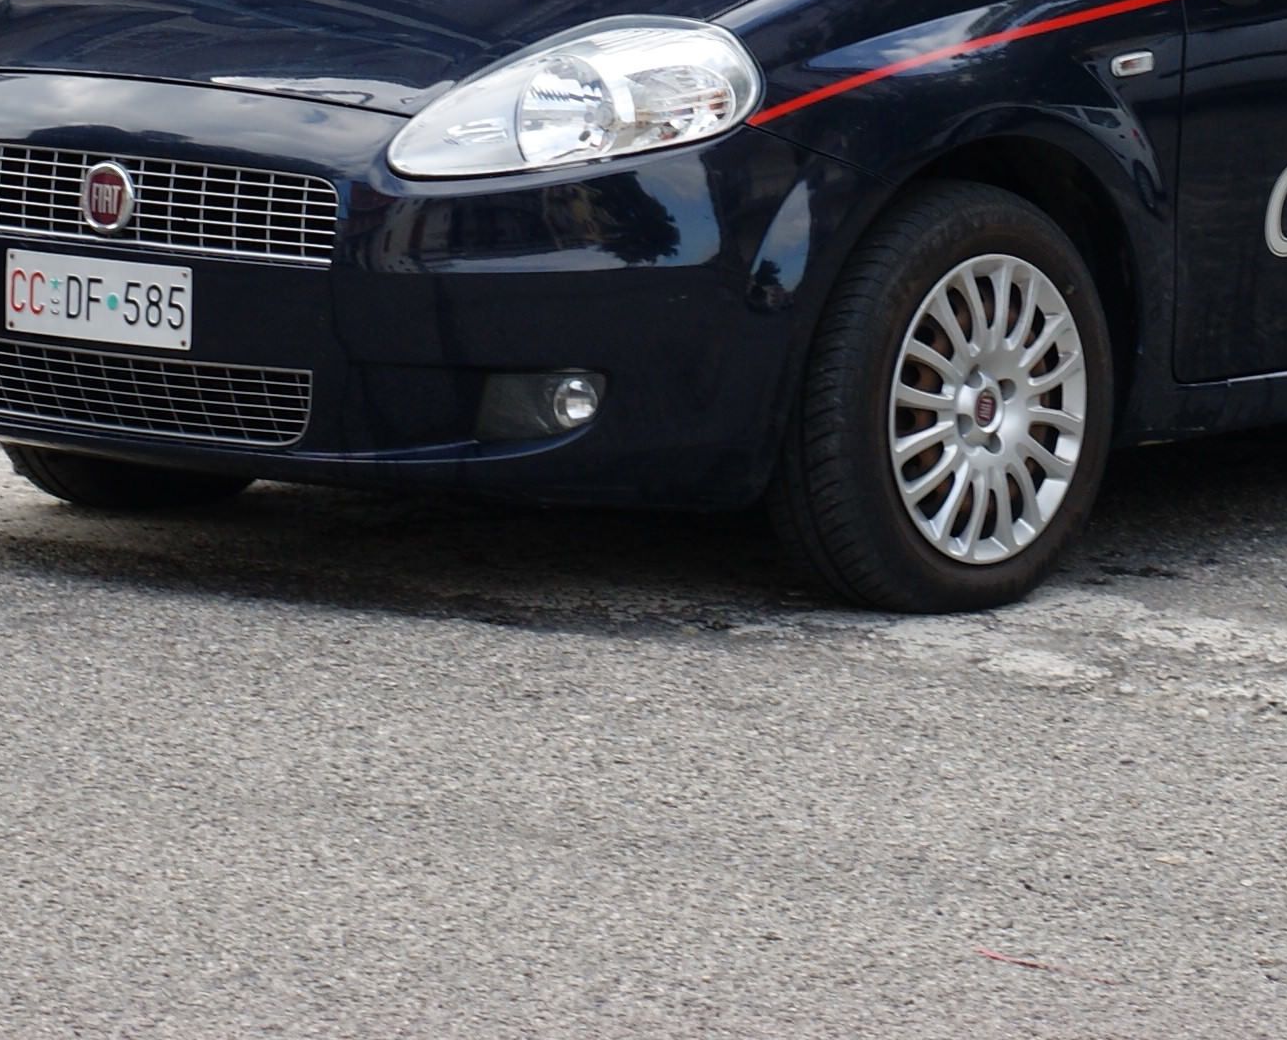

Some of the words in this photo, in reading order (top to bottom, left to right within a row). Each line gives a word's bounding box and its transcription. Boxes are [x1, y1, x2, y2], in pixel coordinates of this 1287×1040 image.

[91, 182, 122, 215] FIAT
[10, 268, 46, 315] CC
[65, 274, 103, 321] DF
[123, 281, 185, 330] 585
